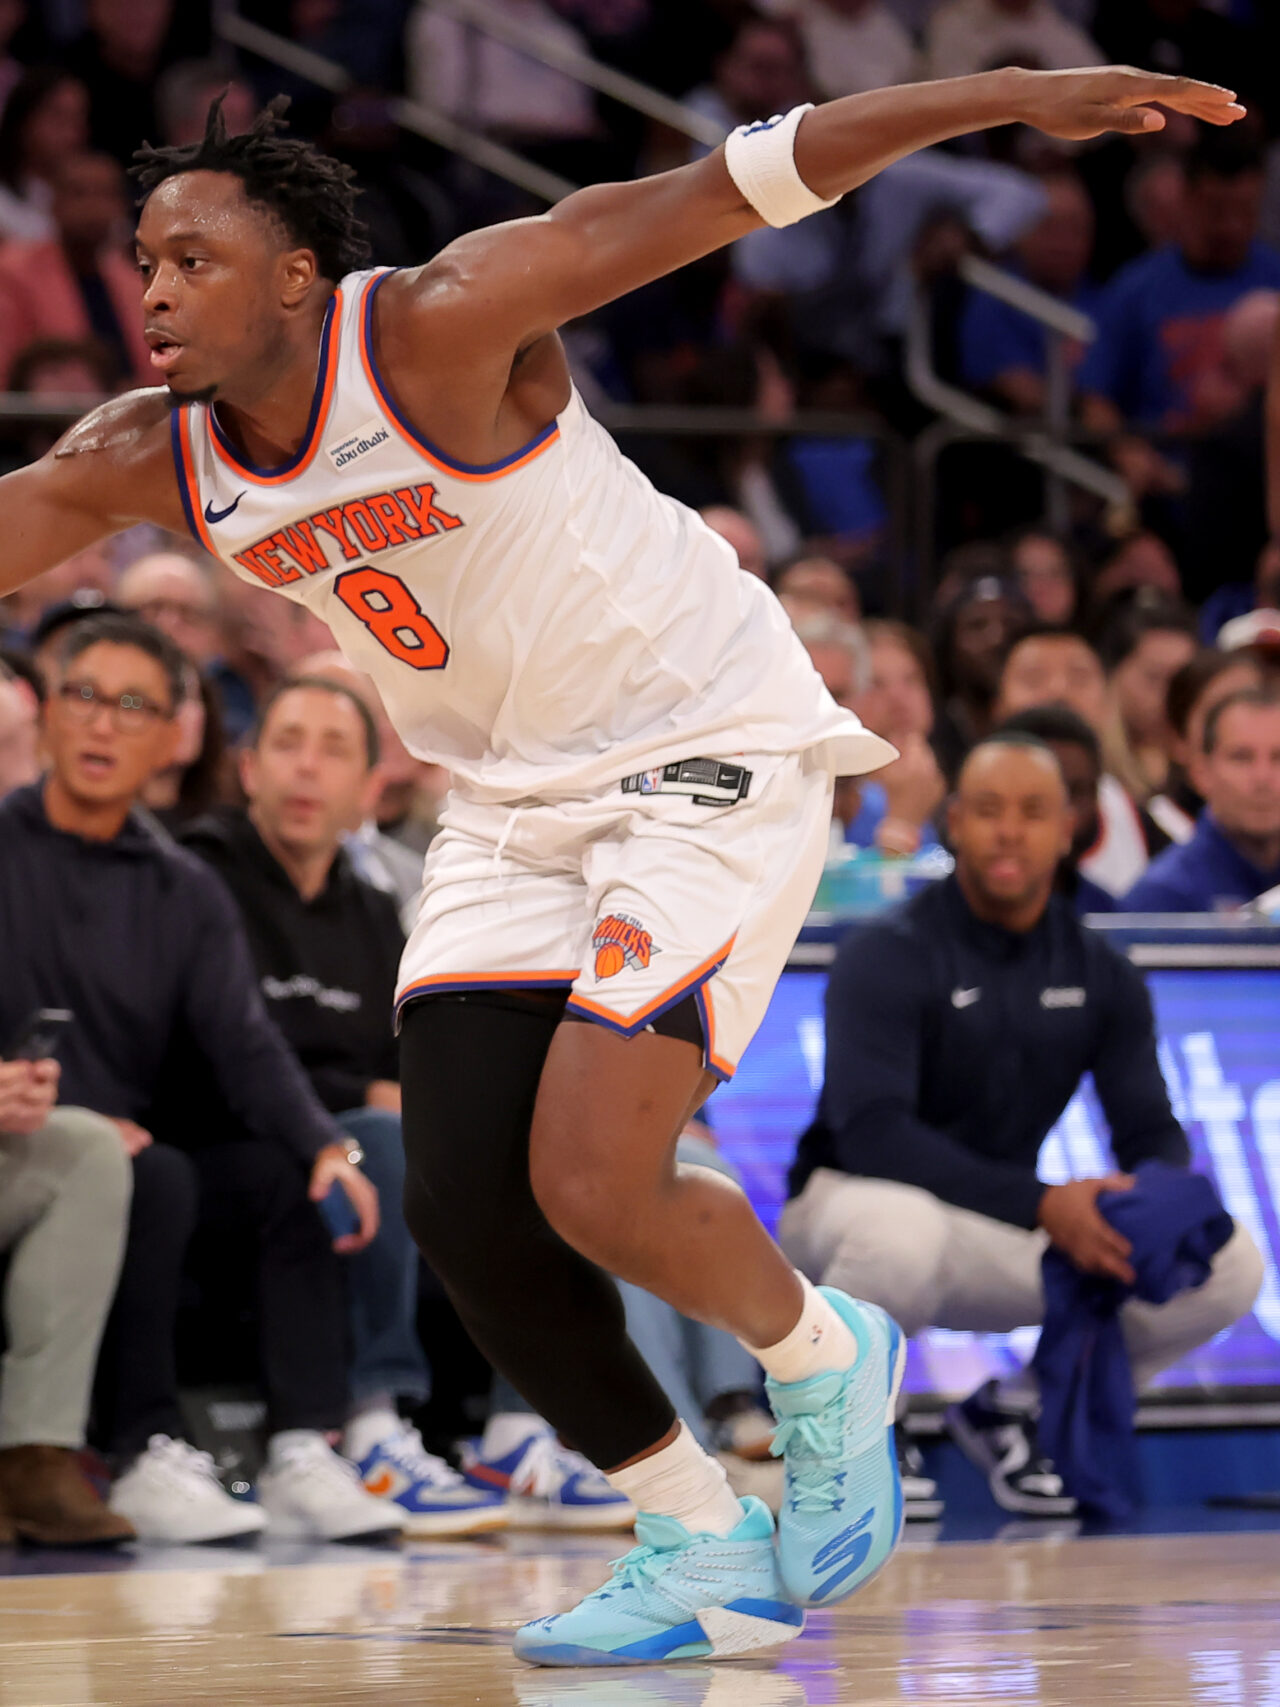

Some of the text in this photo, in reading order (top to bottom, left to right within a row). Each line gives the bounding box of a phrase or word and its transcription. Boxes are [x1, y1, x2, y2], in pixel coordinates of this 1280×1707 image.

[336, 427, 390, 467] abu dhabi
[231, 482, 465, 588] NEW YORK
[333, 565, 450, 670] 8
[592, 914, 653, 968] KNICKS
